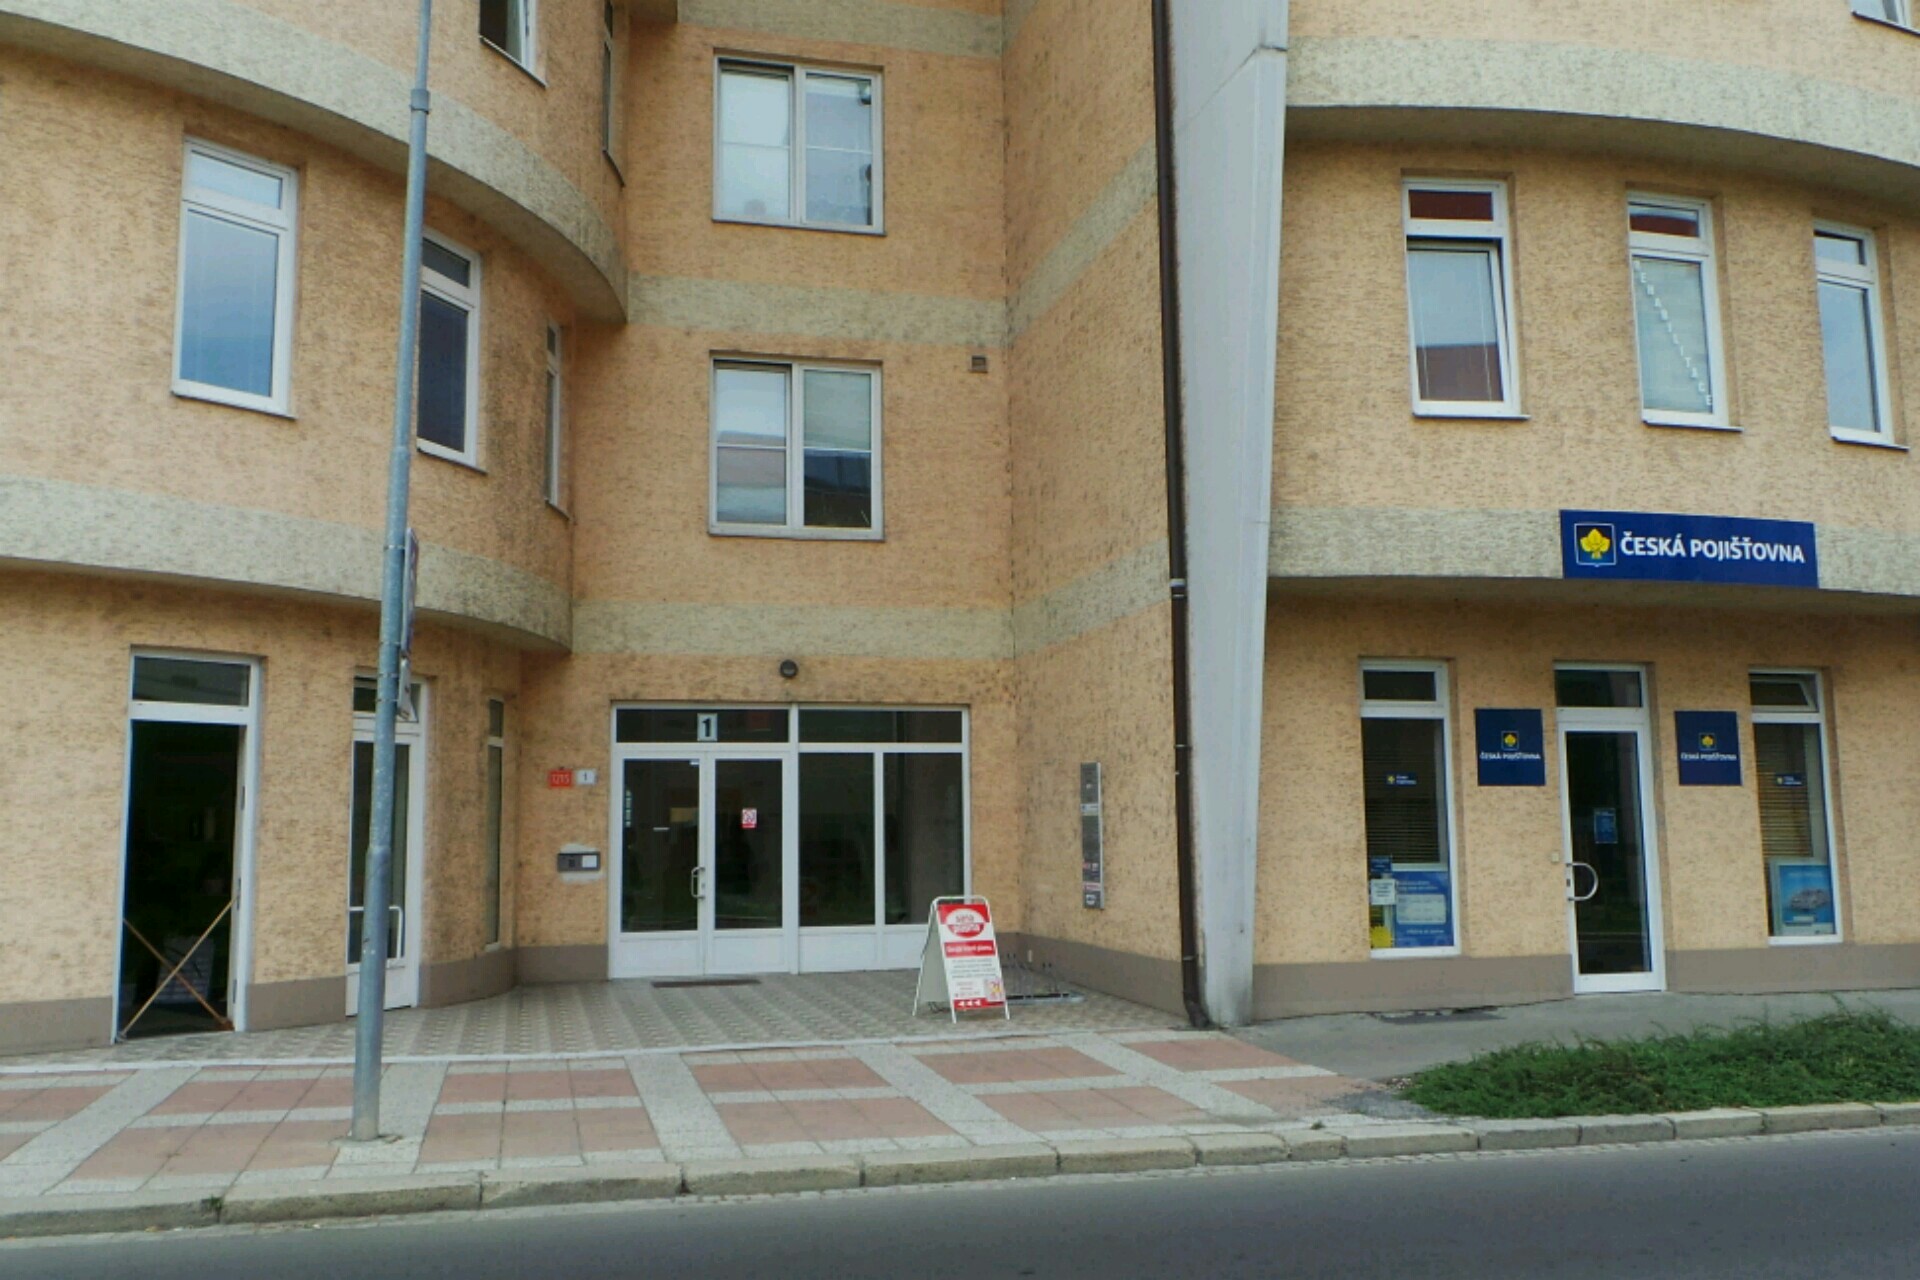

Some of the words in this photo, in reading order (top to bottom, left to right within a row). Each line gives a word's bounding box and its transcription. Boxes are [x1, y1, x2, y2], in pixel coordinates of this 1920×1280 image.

[1634, 260, 1713, 405] REHABILITACE
[1620, 531, 1686, 557] ČESKÁ
[1690, 536, 1805, 563] POJIŠŤOVNA
[702, 718, 711, 737] 1
